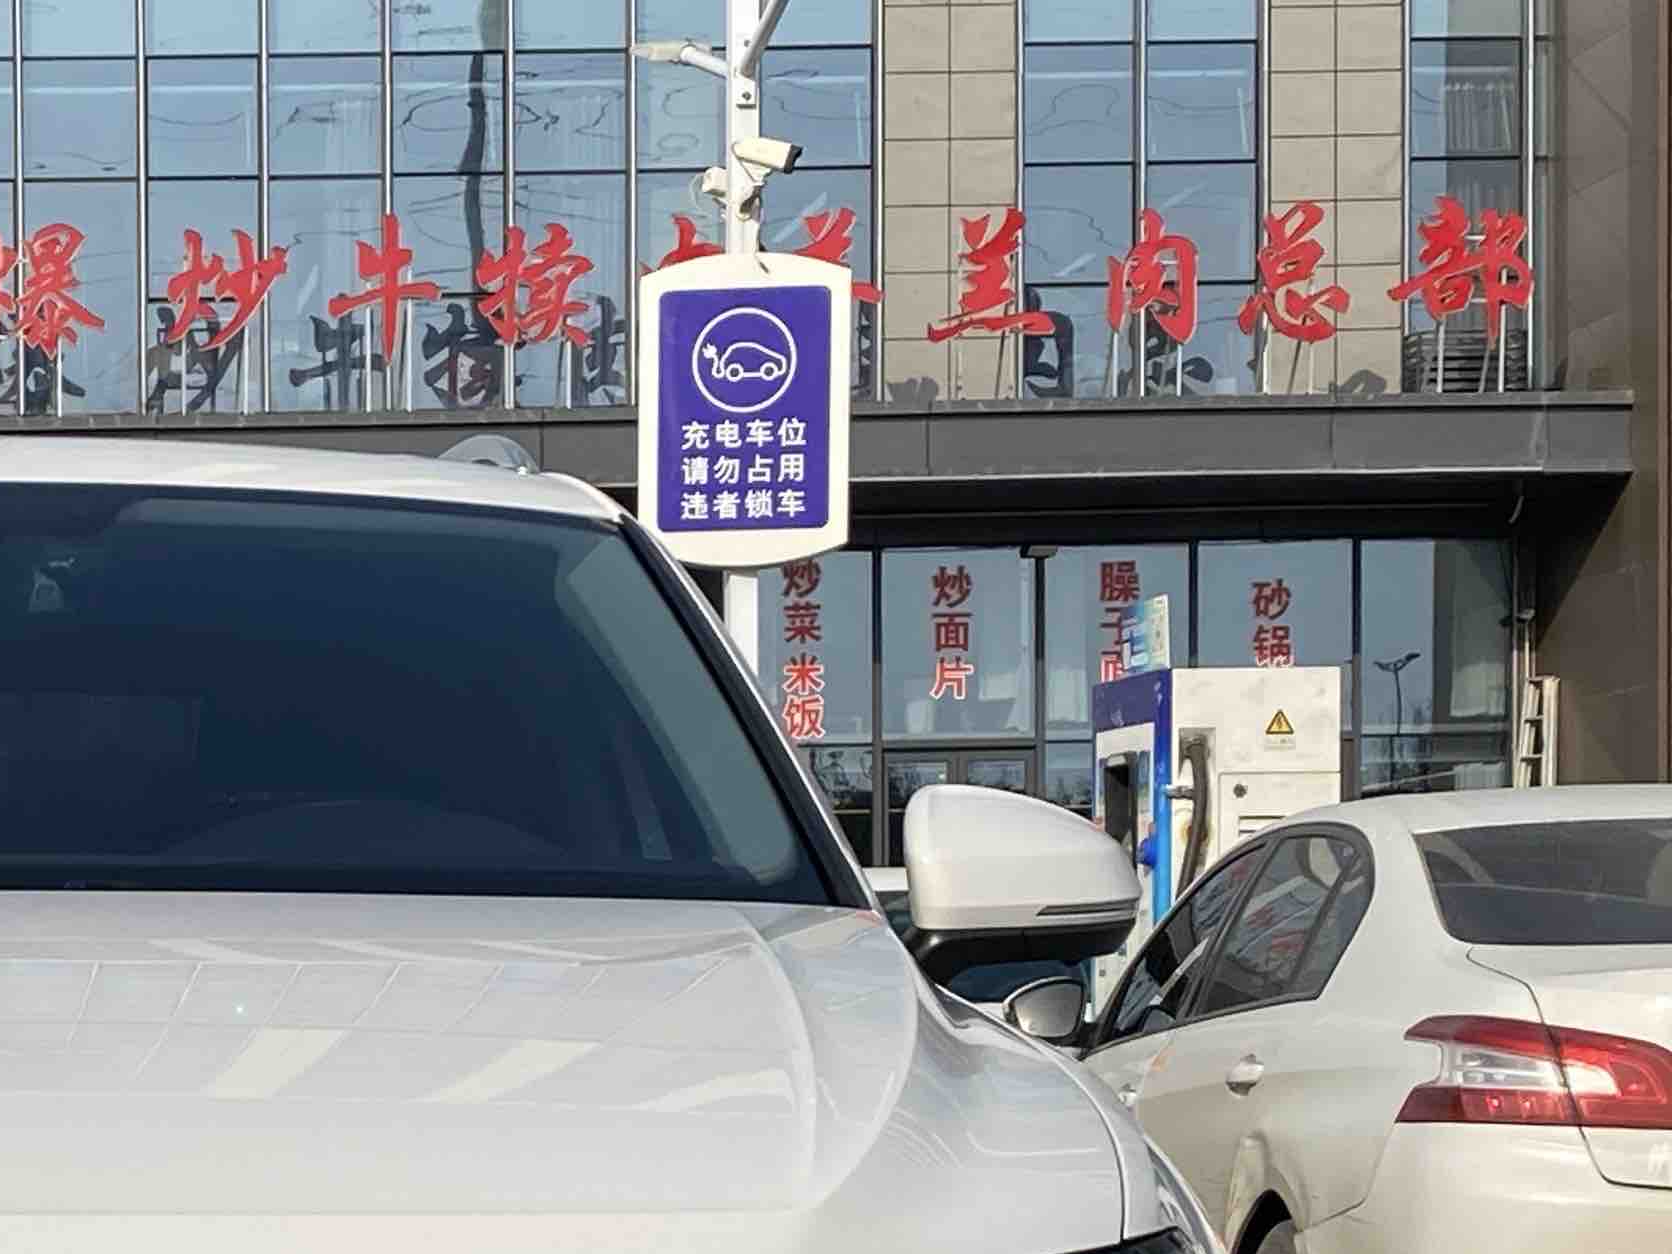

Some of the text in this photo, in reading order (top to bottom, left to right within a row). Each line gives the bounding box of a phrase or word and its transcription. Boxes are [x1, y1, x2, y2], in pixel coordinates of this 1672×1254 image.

[681, 417, 806, 450] 充电车位
[681, 453, 805, 485] 请勿占用
[680, 489, 806, 520] 违者锁车
[782, 558, 826, 739] 炒菜米饭
[929, 565, 974, 700] 炒面片
[1251, 577, 1294, 667] 砂锅
